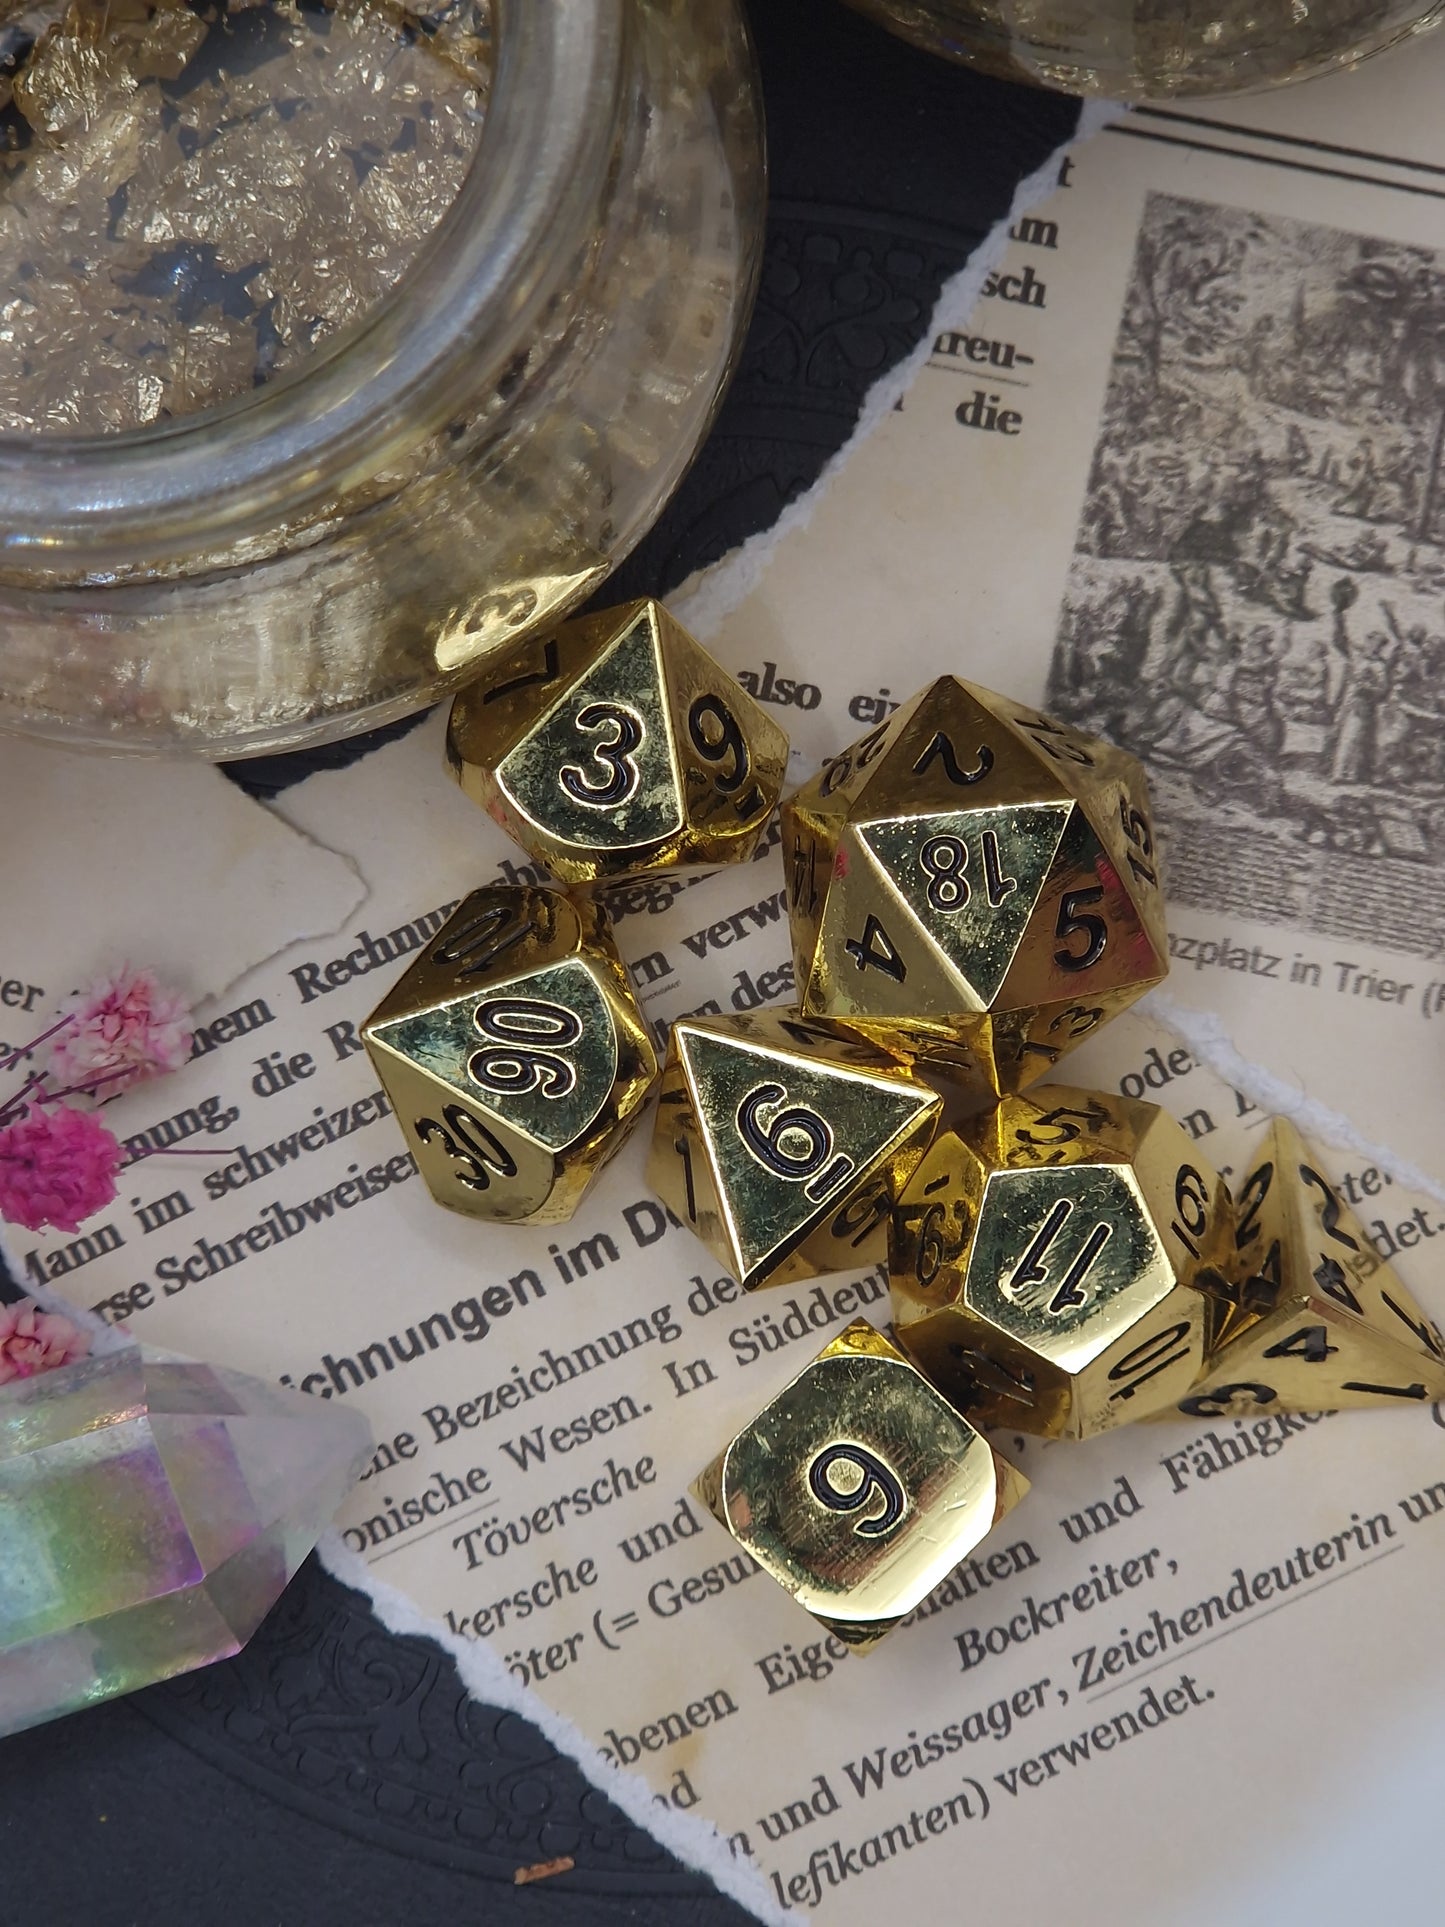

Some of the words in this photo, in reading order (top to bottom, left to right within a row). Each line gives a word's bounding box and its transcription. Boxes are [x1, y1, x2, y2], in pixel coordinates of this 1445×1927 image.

[955, 390, 1024, 436] die
[737, 661, 823, 711] also
[848, 687, 901, 726] ei
[558, 700, 646, 808] 3
[911, 730, 996, 786] 2
[920, 830, 1019, 914] 18
[845, 913, 908, 984] 4
[1053, 886, 1108, 973] 5
[1290, 952, 1321, 987] in
[1333, 960, 1415, 1006] Trier
[251, 1050, 318, 1099] die
[1119, 1047, 1202, 1100] ode
[414, 1103, 517, 1191] 30
[131, 1197, 195, 1235] im
[1011, 1202, 1111, 1313] 11
[279, 1268, 548, 1402] chnungen
[548, 1231, 621, 1285] im
[422, 1304, 683, 1445] Bezeichnung
[687, 1275, 746, 1317] de
[499, 1394, 652, 1472] Wesen.
[662, 1358, 718, 1398] In
[452, 1455, 657, 1571] Töversche
[618, 1497, 704, 1563] und
[1058, 1475, 1145, 1545] und
[592, 1608, 640, 1651] (=
[953, 1545, 1179, 1673] Bockreiter,
[756, 1774, 842, 1842] und
[841, 1675, 1070, 1799] Weissager,
[1071, 1512, 1398, 1693] Zeichendeuterin
[992, 1672, 1216, 1797] verwendet.
